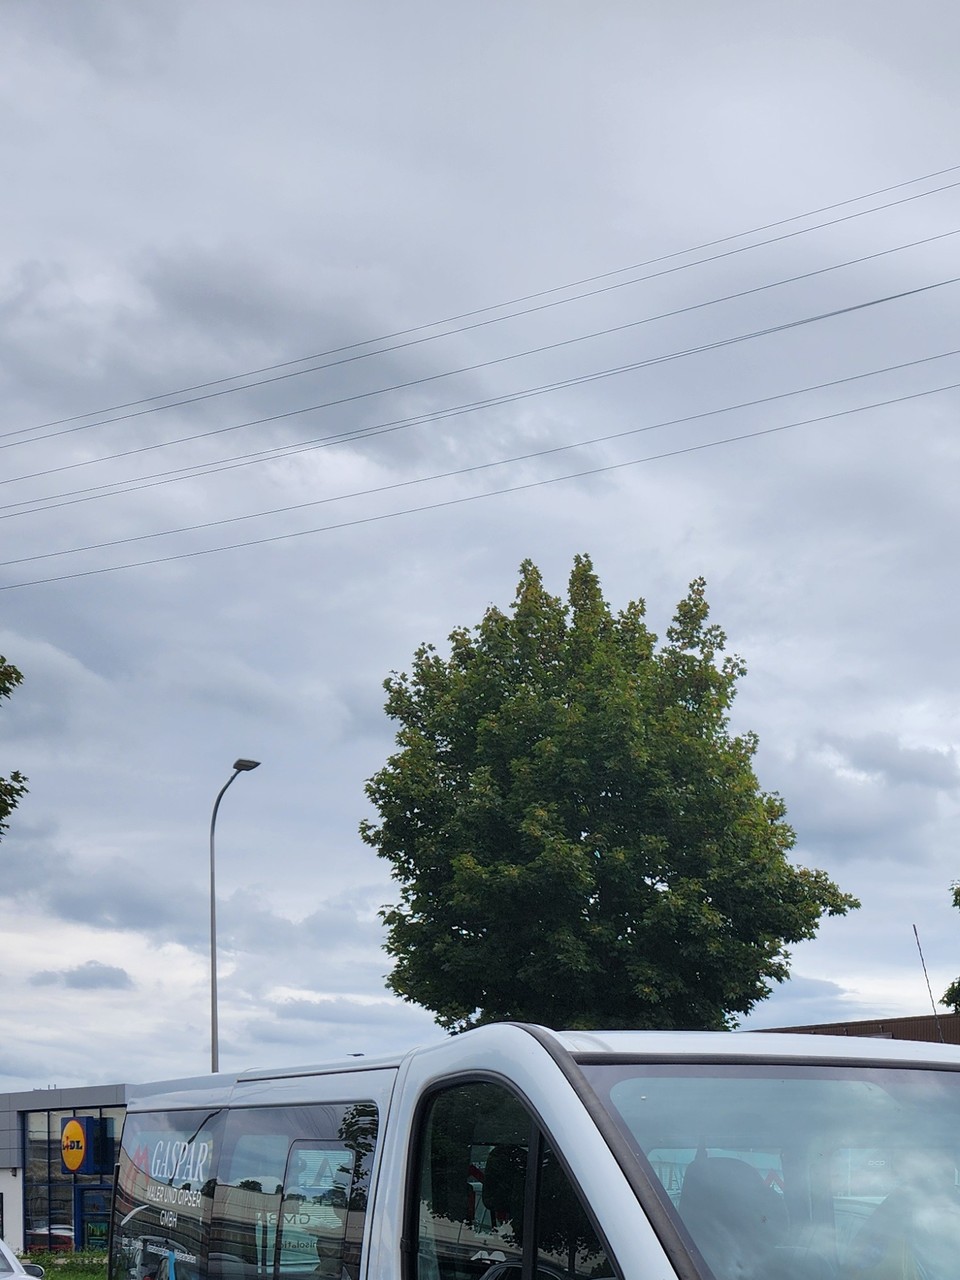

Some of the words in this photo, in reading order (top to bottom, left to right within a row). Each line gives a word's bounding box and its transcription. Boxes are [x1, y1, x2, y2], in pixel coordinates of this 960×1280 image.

[151, 1140, 209, 1183] GASPAR
[147, 1185, 164, 1201] MALER
[164, 1188, 177, 1204] UND
[177, 1190, 202, 1208] GIPSER
